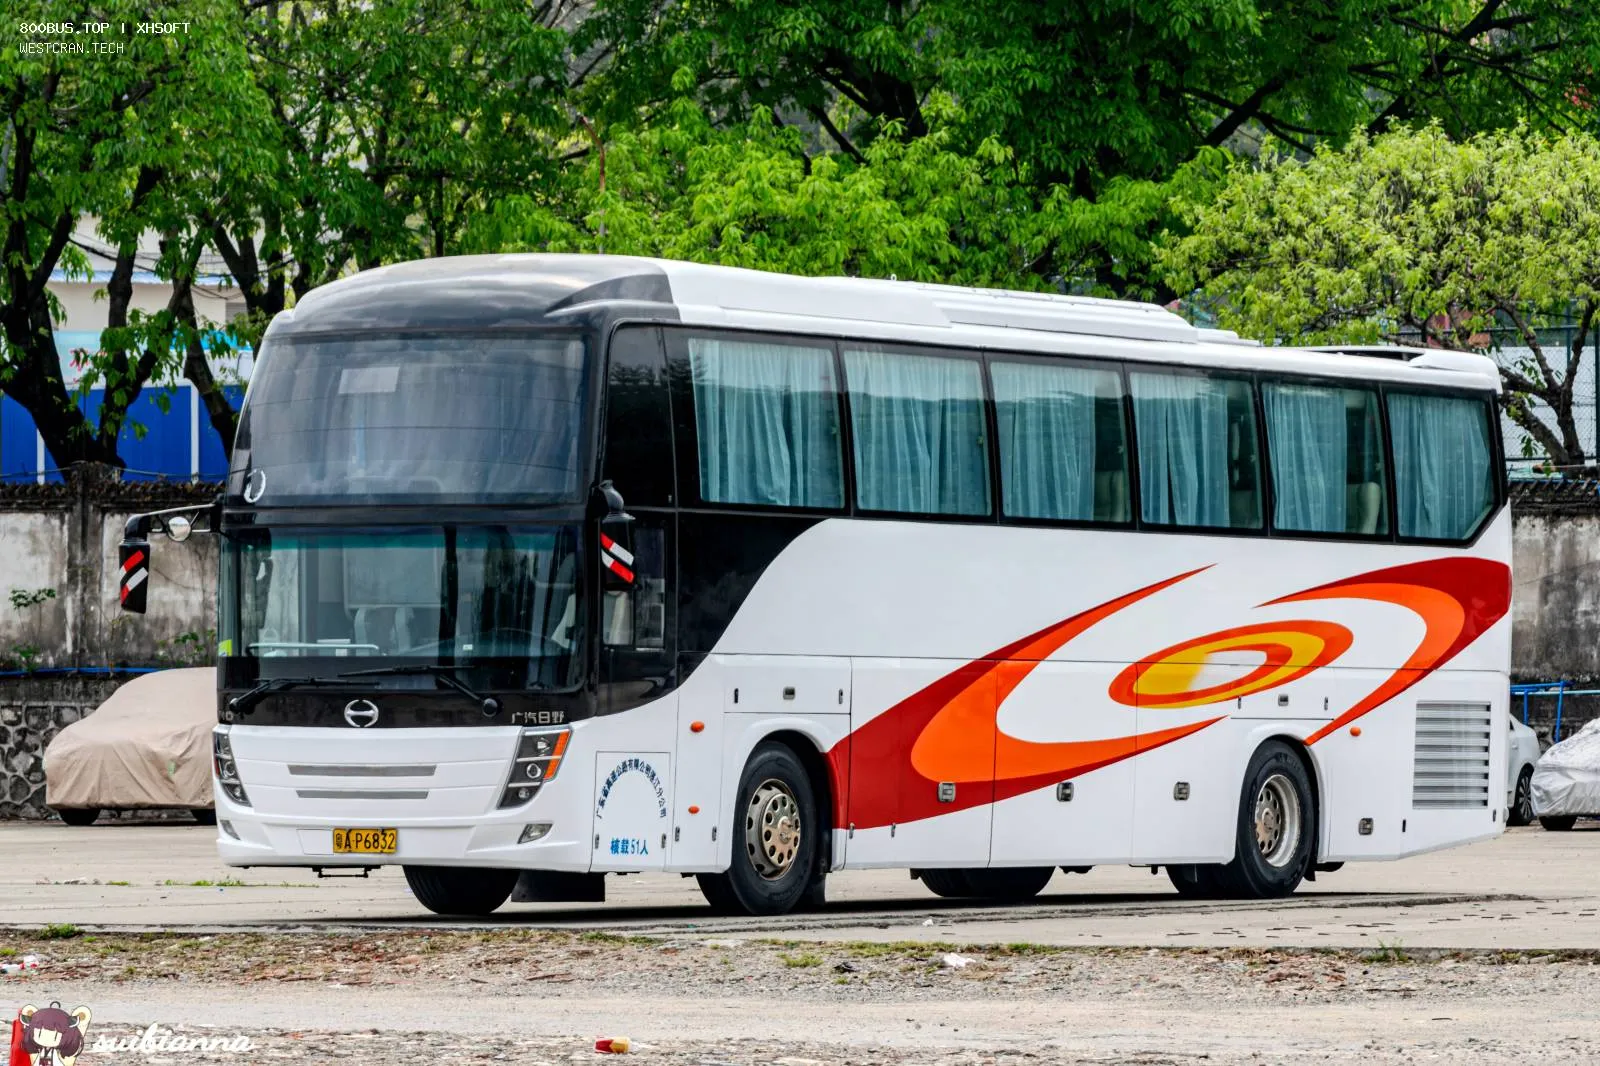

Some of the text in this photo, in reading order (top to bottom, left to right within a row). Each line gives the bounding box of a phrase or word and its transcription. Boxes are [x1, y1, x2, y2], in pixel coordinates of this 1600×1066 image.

[511, 710, 565, 724] 广汽日野
[610, 837, 649, 855] 核载51人
